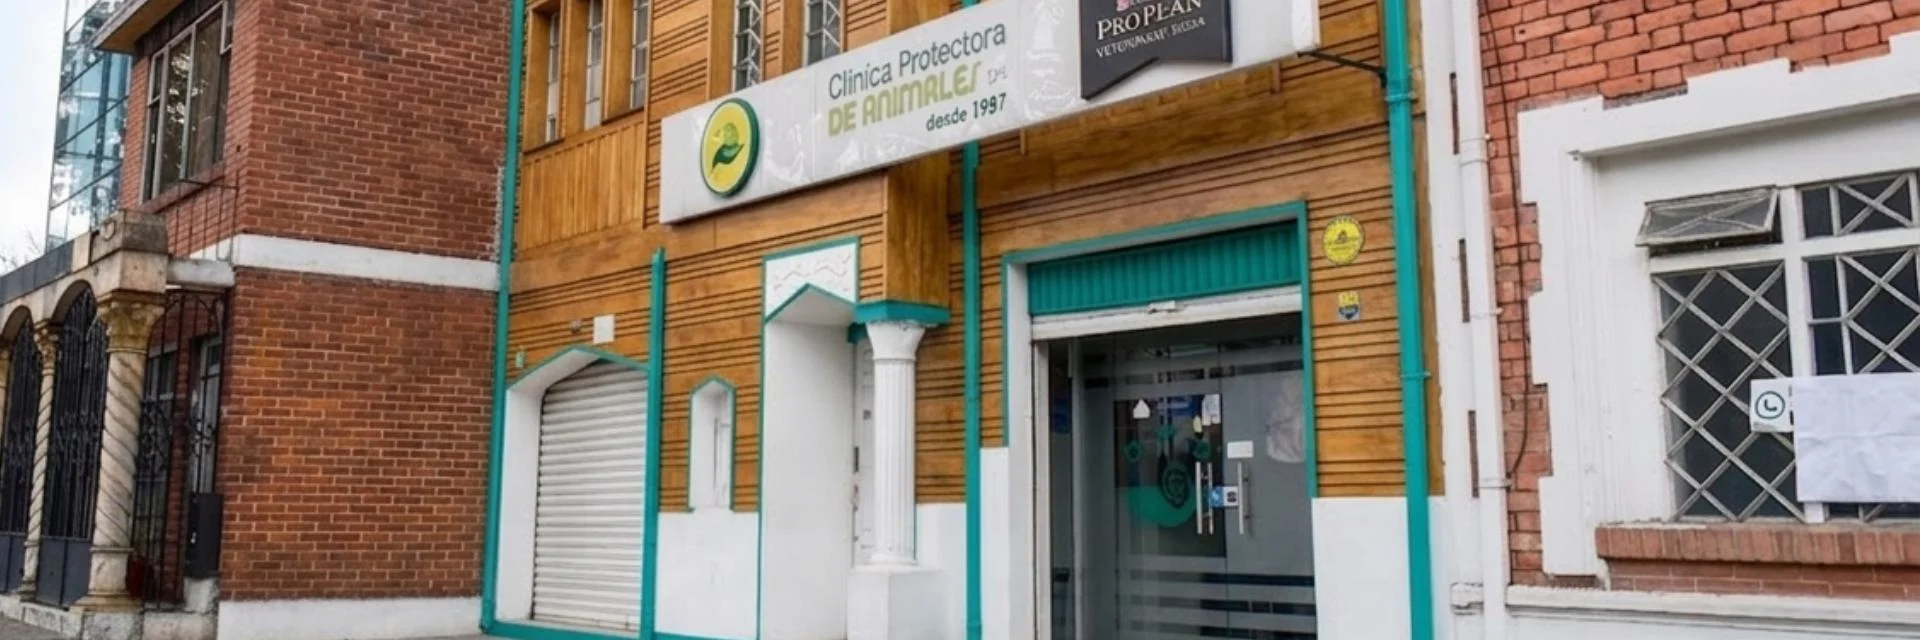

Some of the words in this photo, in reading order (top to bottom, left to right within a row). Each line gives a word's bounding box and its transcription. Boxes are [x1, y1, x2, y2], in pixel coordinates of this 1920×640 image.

[899, 23, 1006, 77] Protectora
[828, 100, 858, 137] DE
[926, 107, 968, 131] desde
